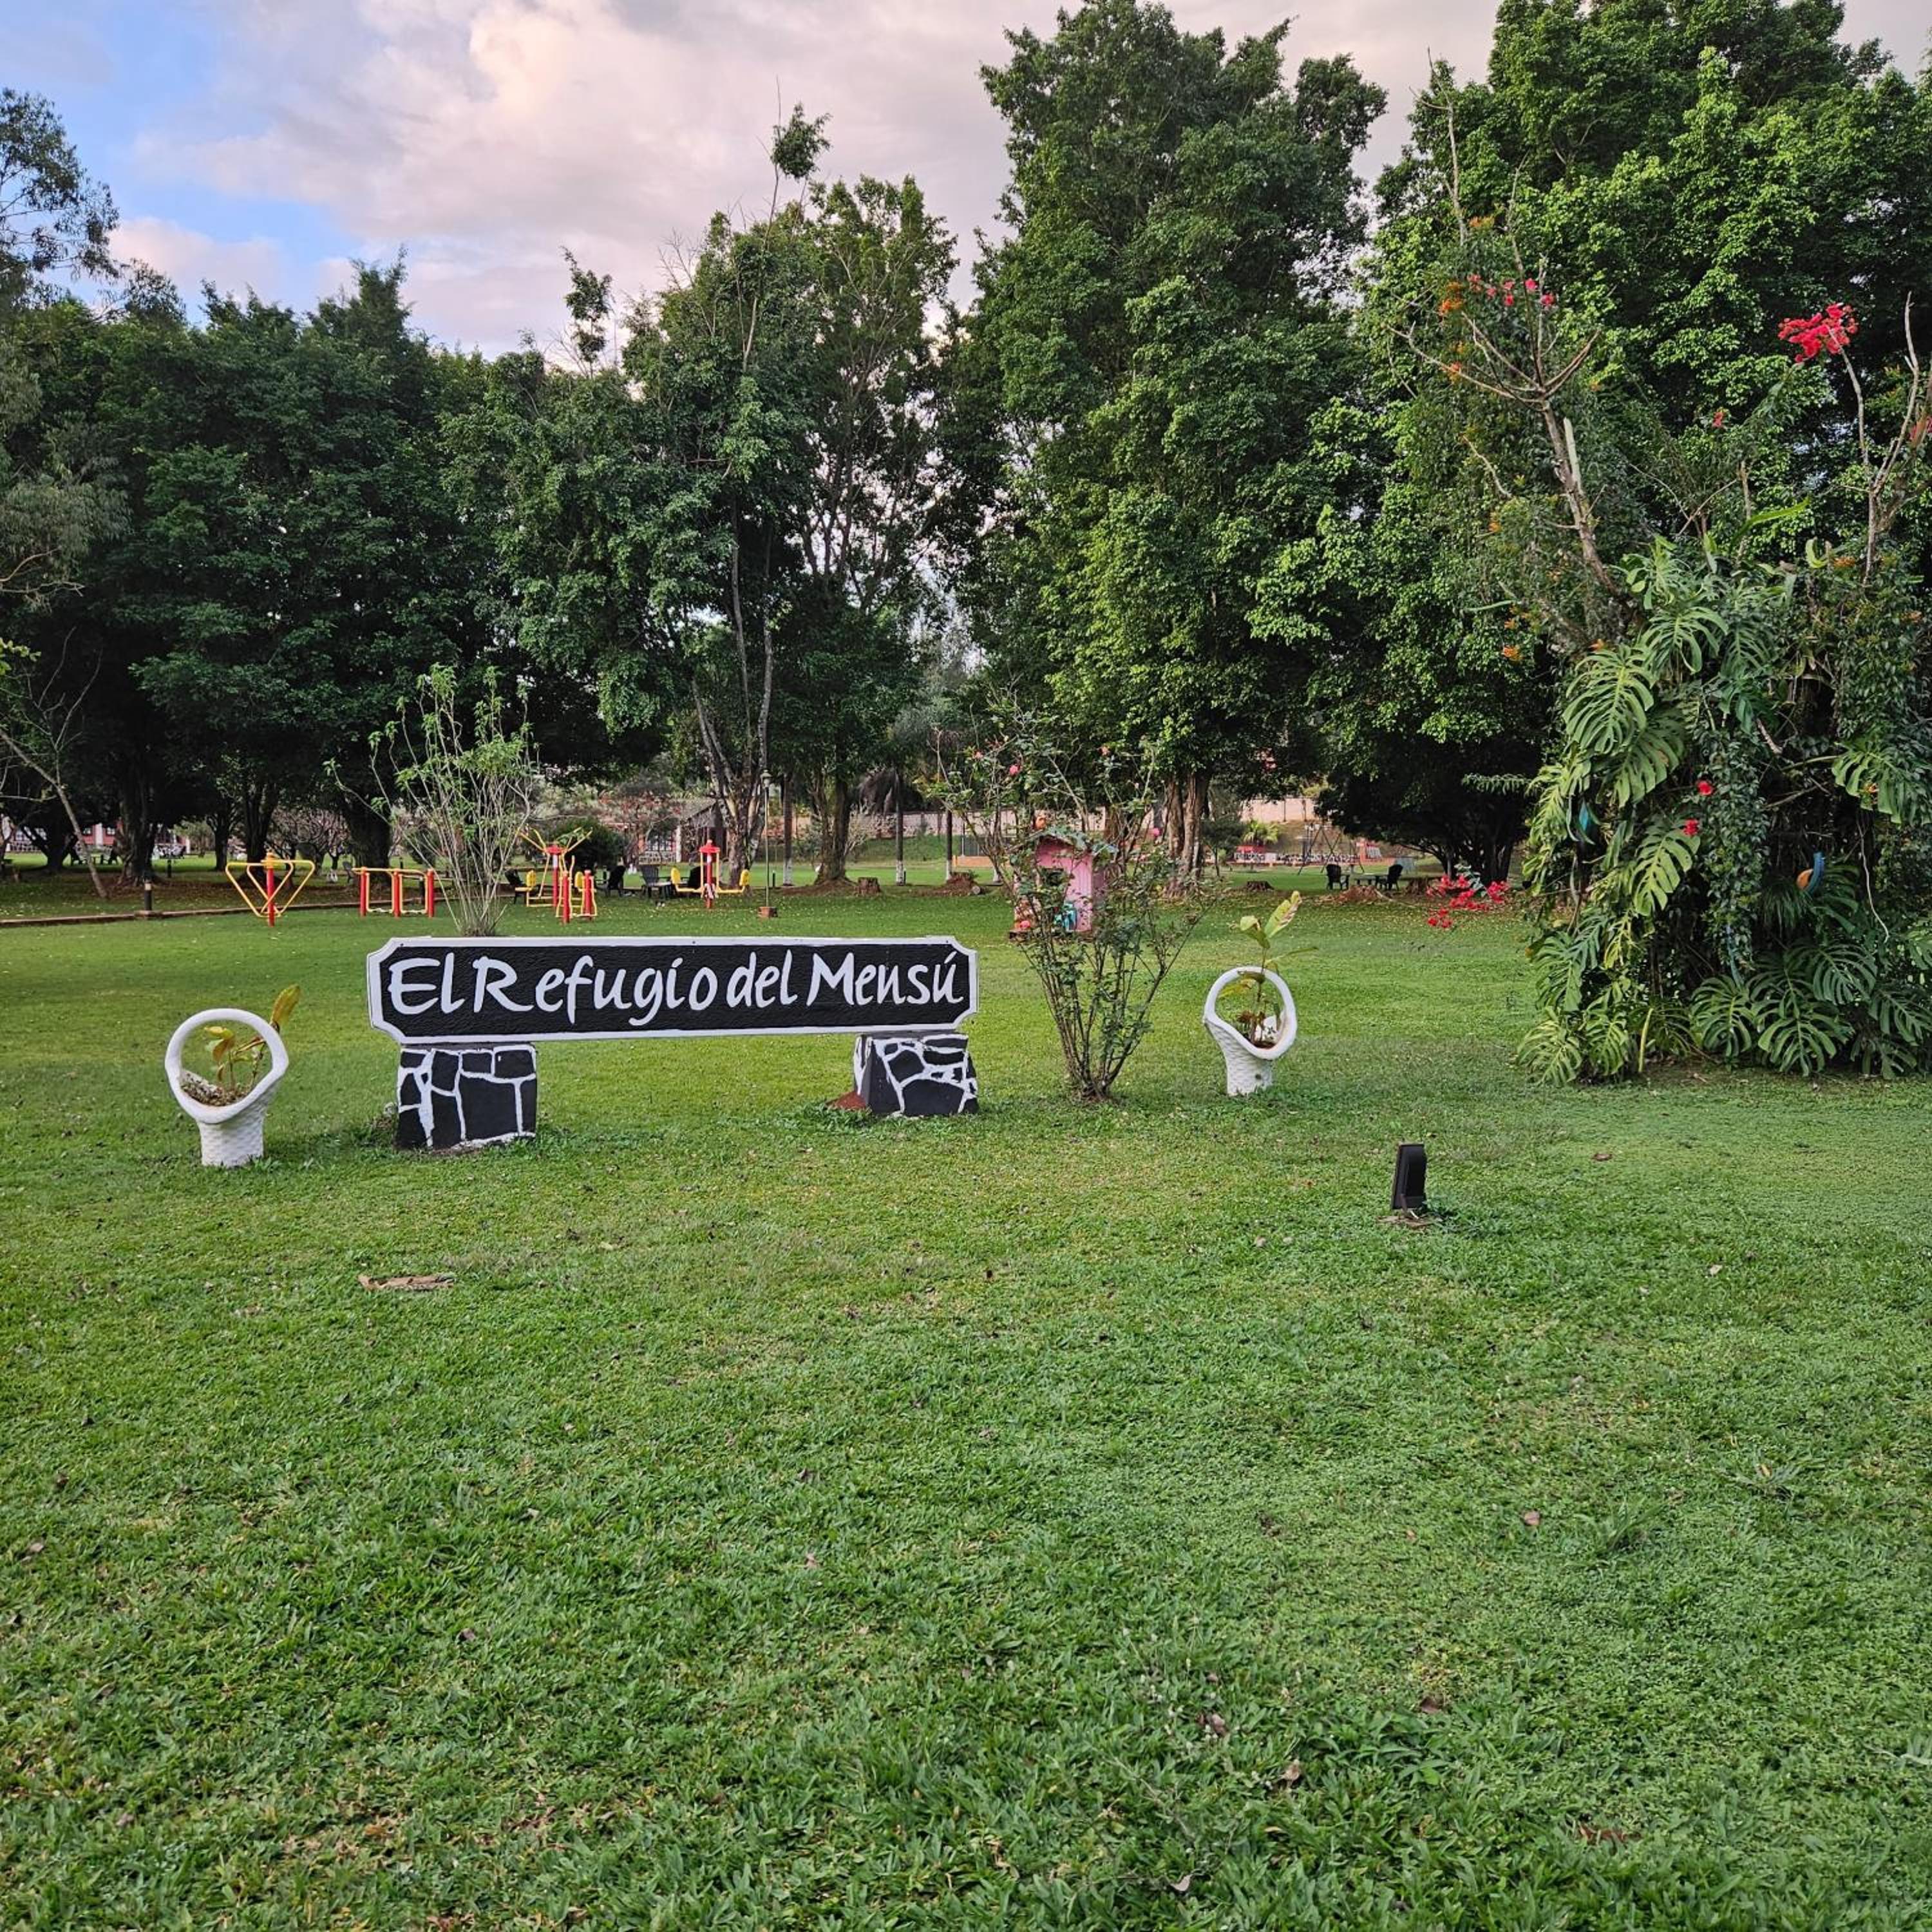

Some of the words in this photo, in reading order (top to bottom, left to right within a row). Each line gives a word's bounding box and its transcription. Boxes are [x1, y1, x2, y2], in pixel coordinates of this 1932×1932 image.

[388, 952, 465, 1015] El
[726, 949, 798, 1008] del
[806, 951, 964, 1007] Mensú
